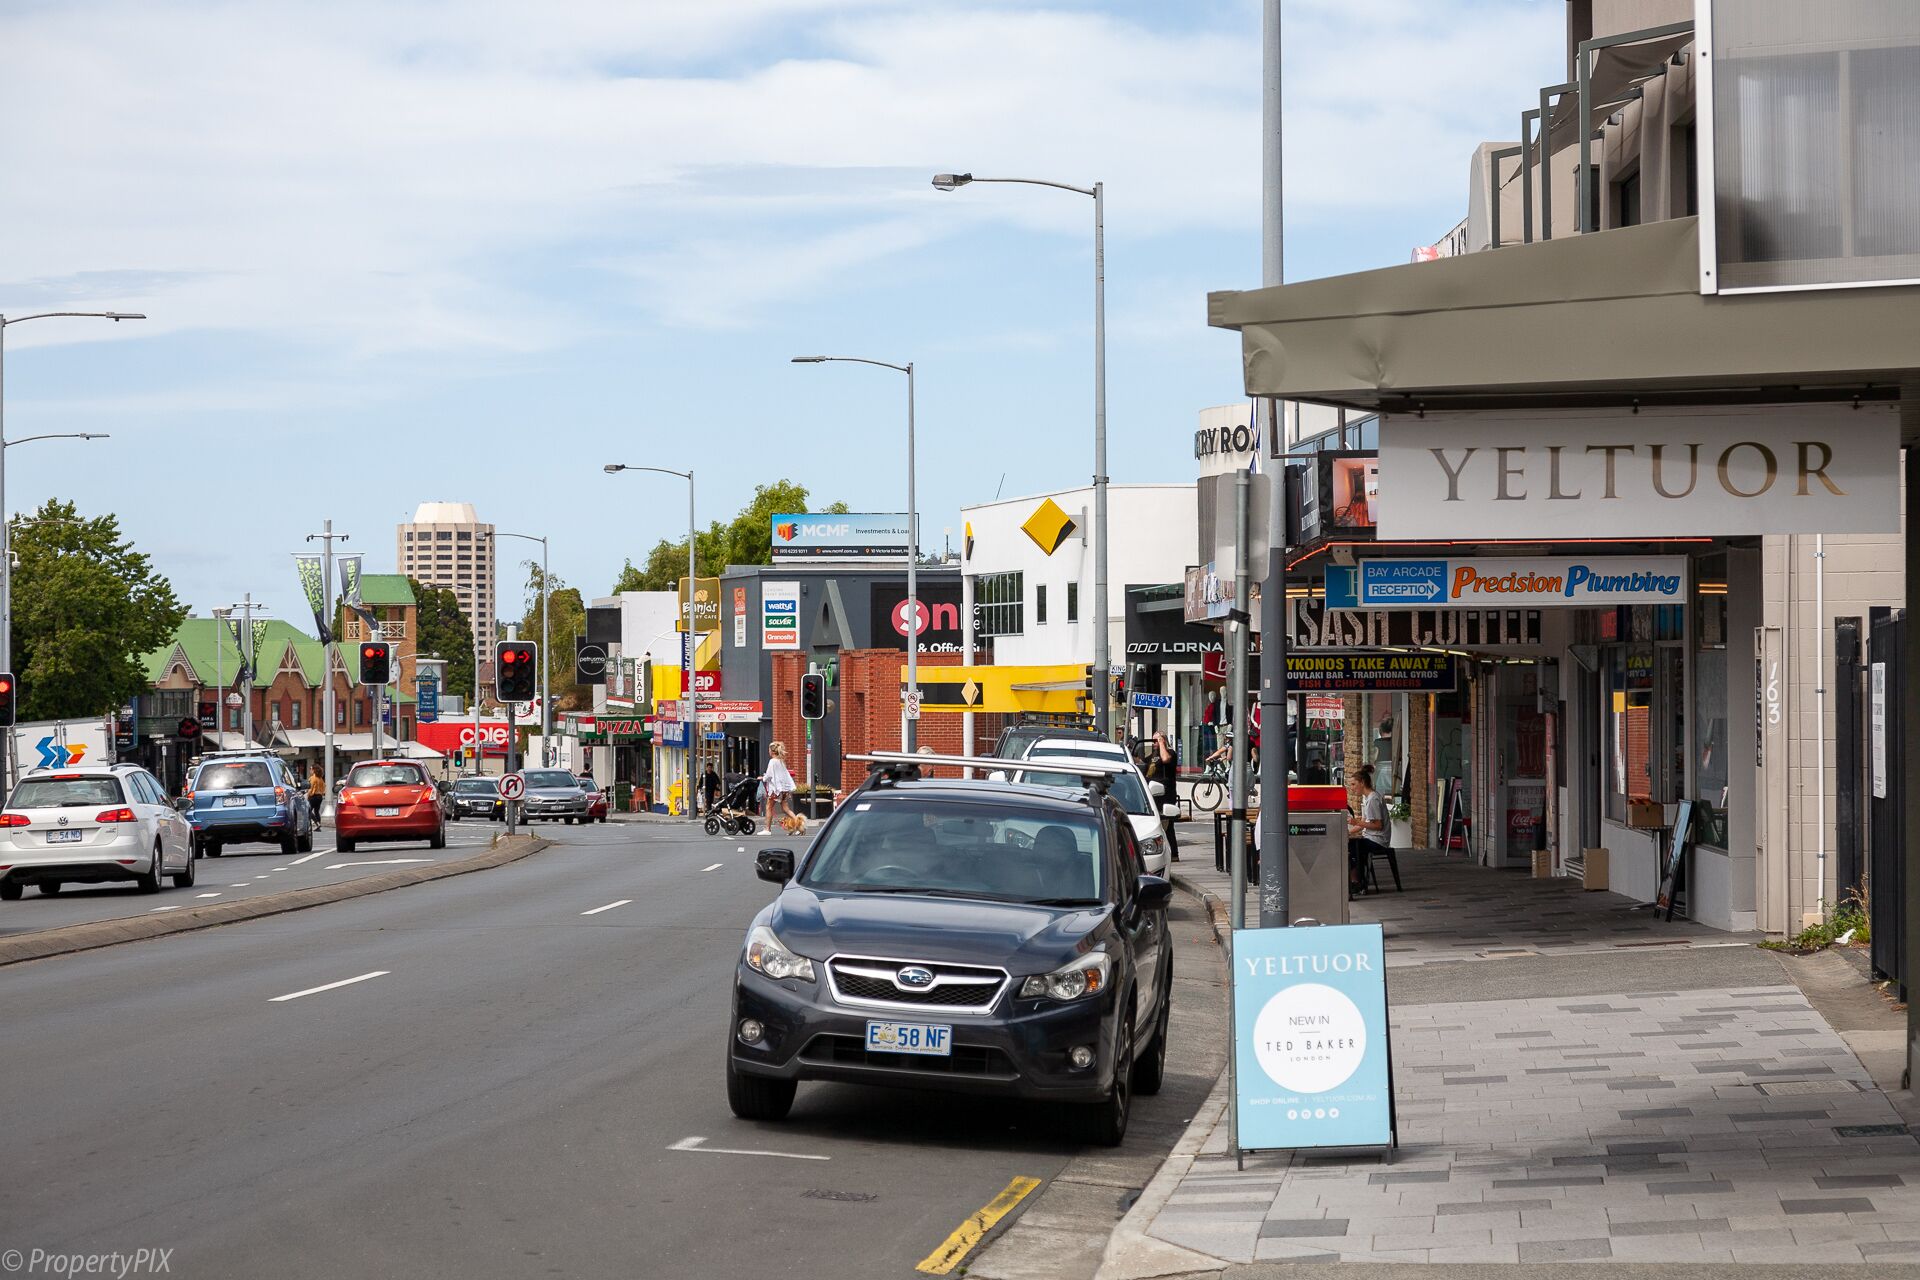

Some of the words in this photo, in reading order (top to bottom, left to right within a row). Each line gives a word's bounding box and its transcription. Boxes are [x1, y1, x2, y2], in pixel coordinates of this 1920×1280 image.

[1221, 424, 1255, 453] RO
[1427, 441, 1849, 502] YELTUOR
[802, 524, 849, 537] MCMF
[1367, 567, 1389, 577] BAY
[1392, 566, 1441, 577] ARCADE
[1451, 566, 1562, 598] Precision
[1565, 565, 1681, 598] Plumbing
[1371, 584, 1434, 595] RECEPTION
[682, 600, 718, 615] Bnjo's
[768, 617, 793, 625] SOLVER
[1162, 642, 1224, 652] LORNA
[1287, 658, 1345, 670] YKONOS
[1349, 658, 1385, 670] TAKE
[1390, 657, 1430, 670] AWAY
[1287, 671, 1324, 679] OUVLAKI
[1326, 671, 1344, 679] BAR
[1353, 671, 1408, 679] TRADITIONAL
[1410, 671, 1439, 679] GYROS
[1299, 680, 1321, 688] FISH
[1324, 680, 1331, 688] &
[1335, 679, 1365, 688] CHIPS
[1376, 679, 1422, 688] BURGERS
[1137, 693, 1165, 703] TOILETS
[1766, 661, 1780, 725] 163
[596, 720, 642, 735] PIZZA
[60, 831, 69, 839] 54
[1245, 953, 1373, 977] YELTUOR
[1289, 1016, 1315, 1026] NEW
[1318, 1015, 1330, 1025] IN
[870, 1025, 881, 1044] E
[898, 1027, 920, 1047] 58
[925, 1027, 949, 1048] NF
[1266, 1040, 1293, 1052] TED
[1306, 1038, 1355, 1050] BAKER
